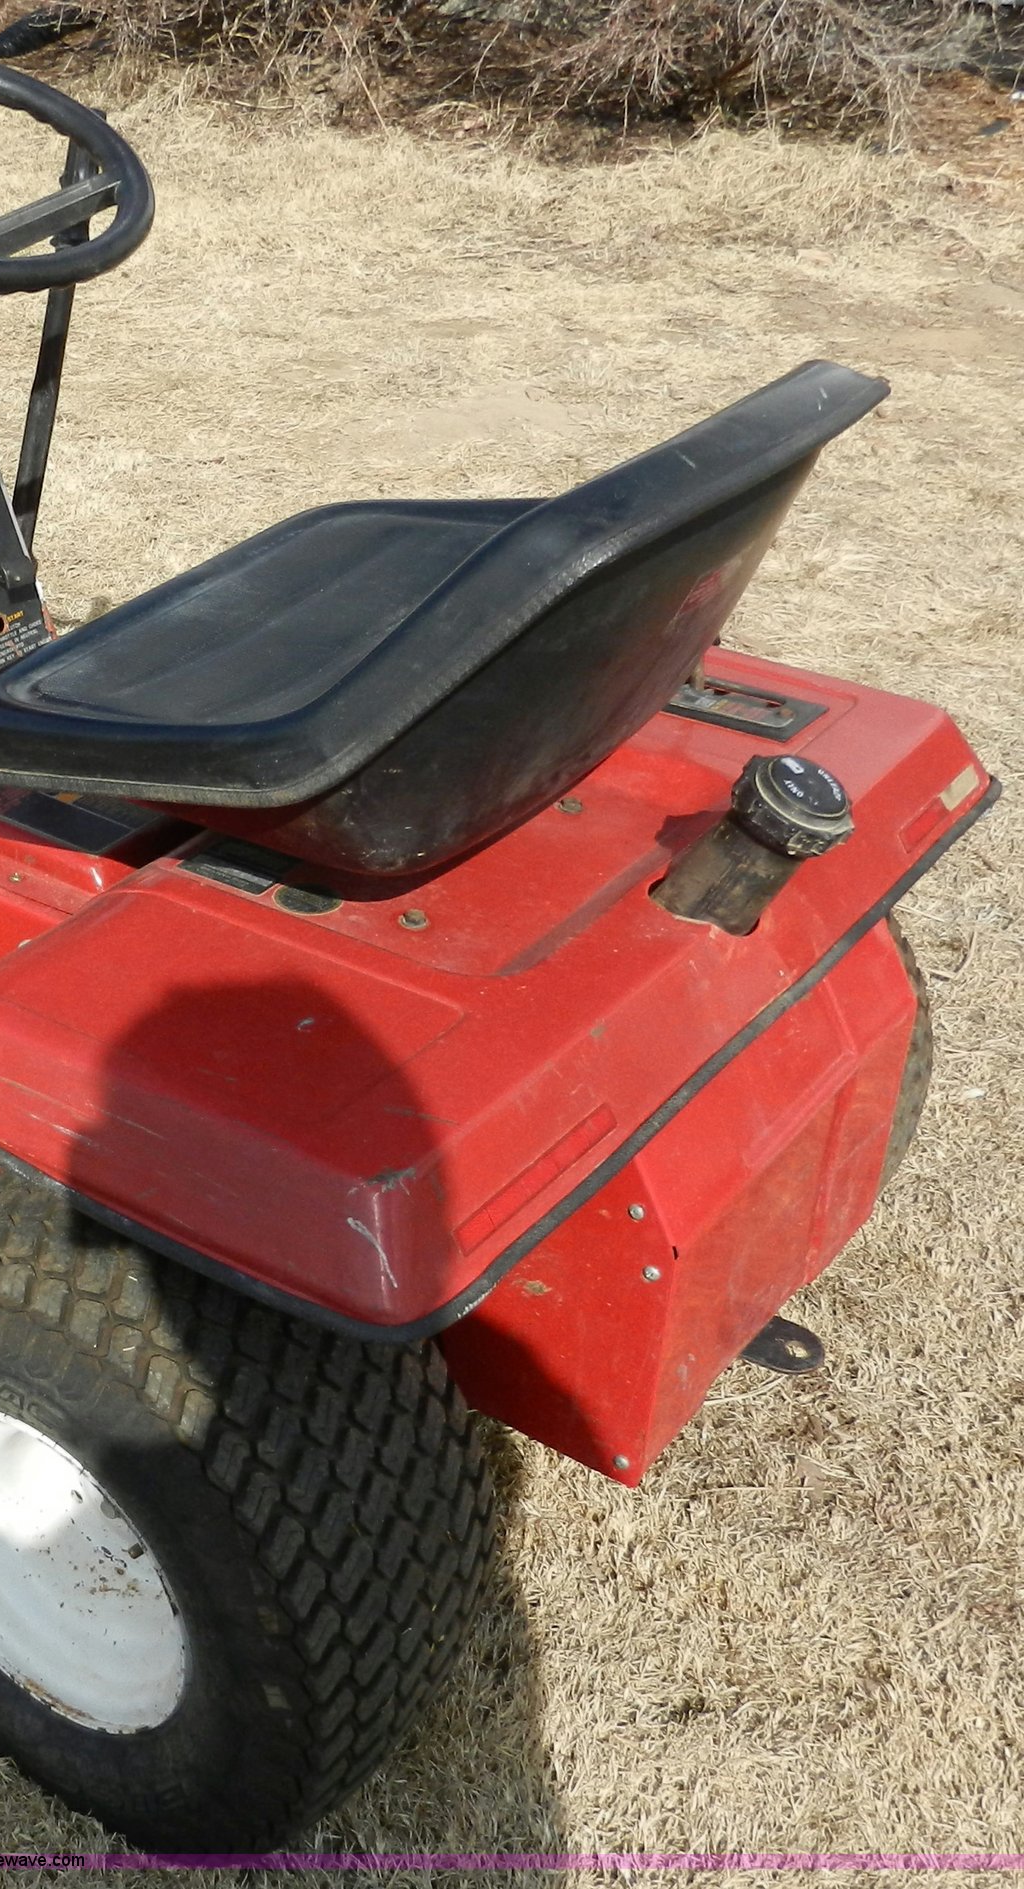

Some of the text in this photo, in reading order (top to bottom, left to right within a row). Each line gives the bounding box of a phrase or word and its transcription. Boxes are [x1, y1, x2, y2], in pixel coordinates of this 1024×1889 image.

[7, 610, 24, 622] START
[23, 643, 37, 653] START
[783, 779, 804, 798] ONLY
